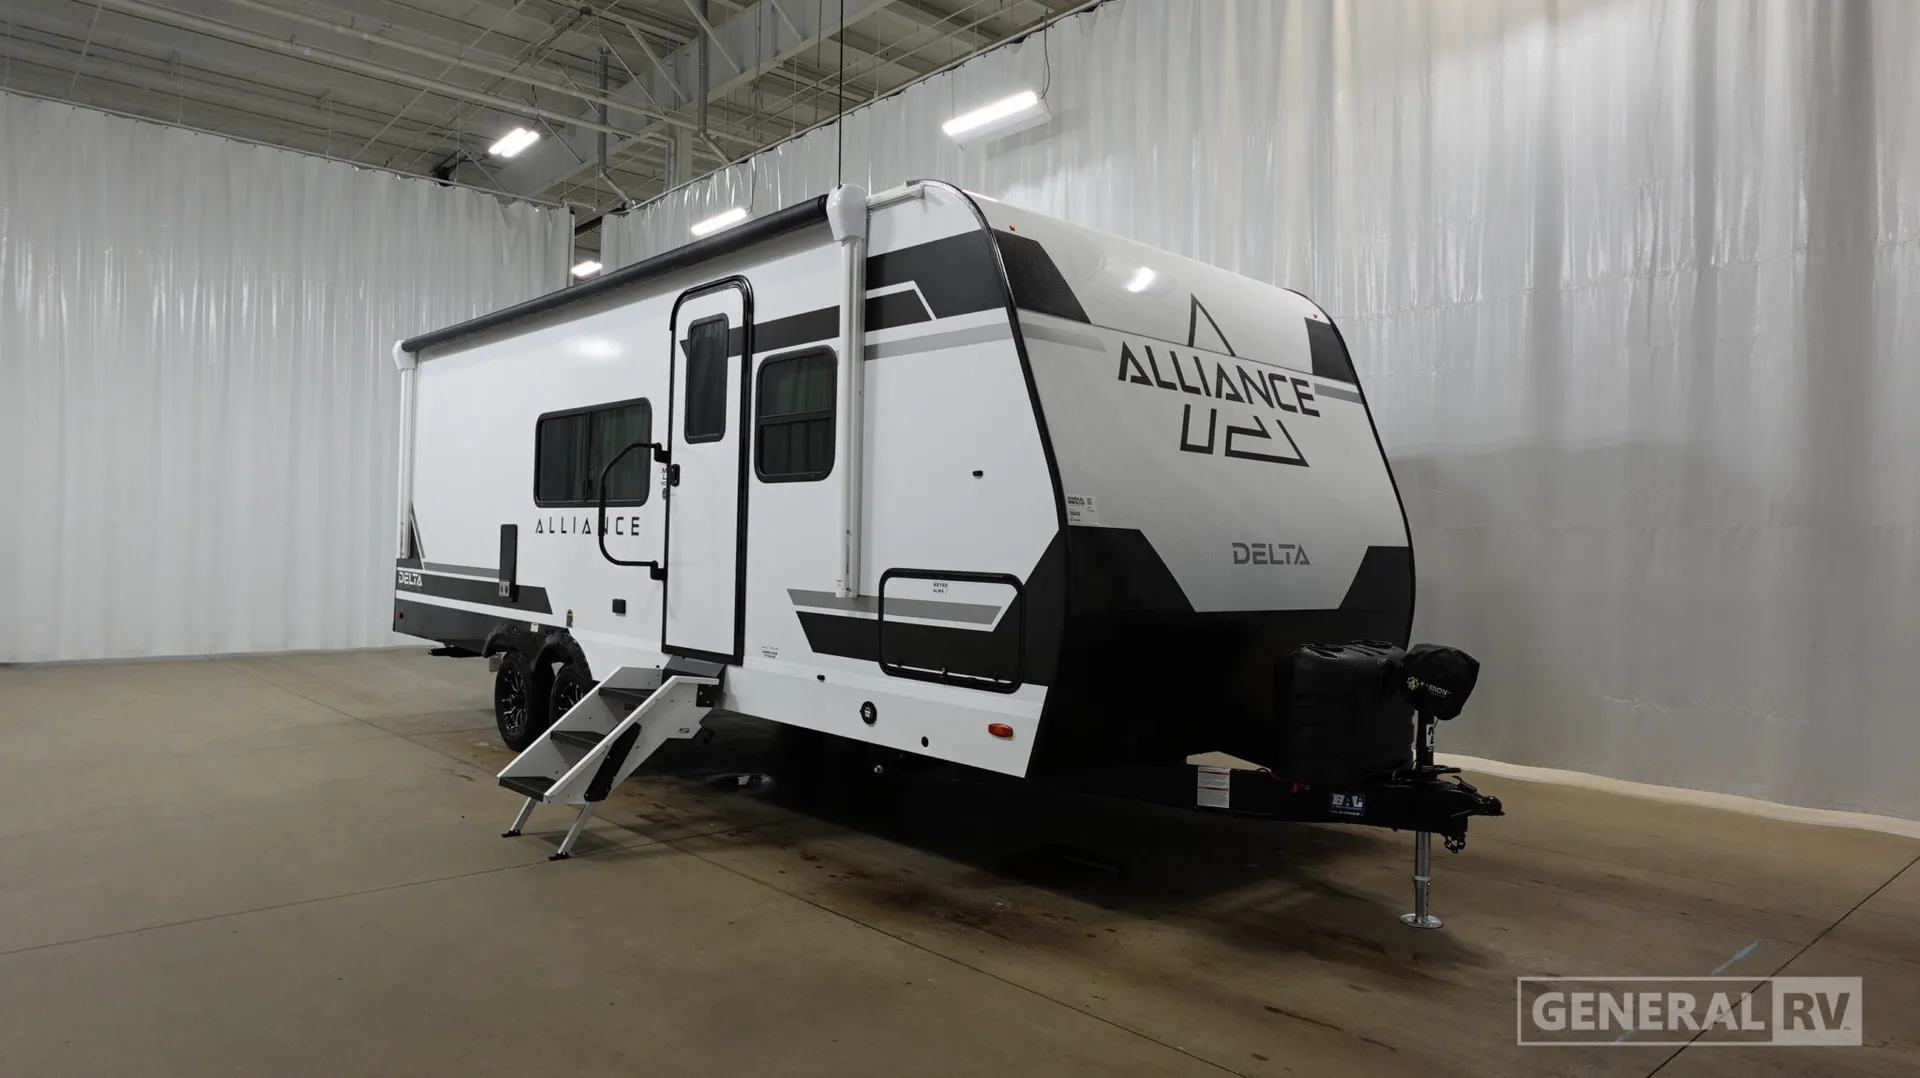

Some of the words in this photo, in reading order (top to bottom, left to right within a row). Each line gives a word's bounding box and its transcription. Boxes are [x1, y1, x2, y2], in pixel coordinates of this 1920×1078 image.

[1118, 341, 1320, 417] ALLIANCE
[1232, 542, 1310, 565] DELTA
[399, 571, 422, 587] DELTA
